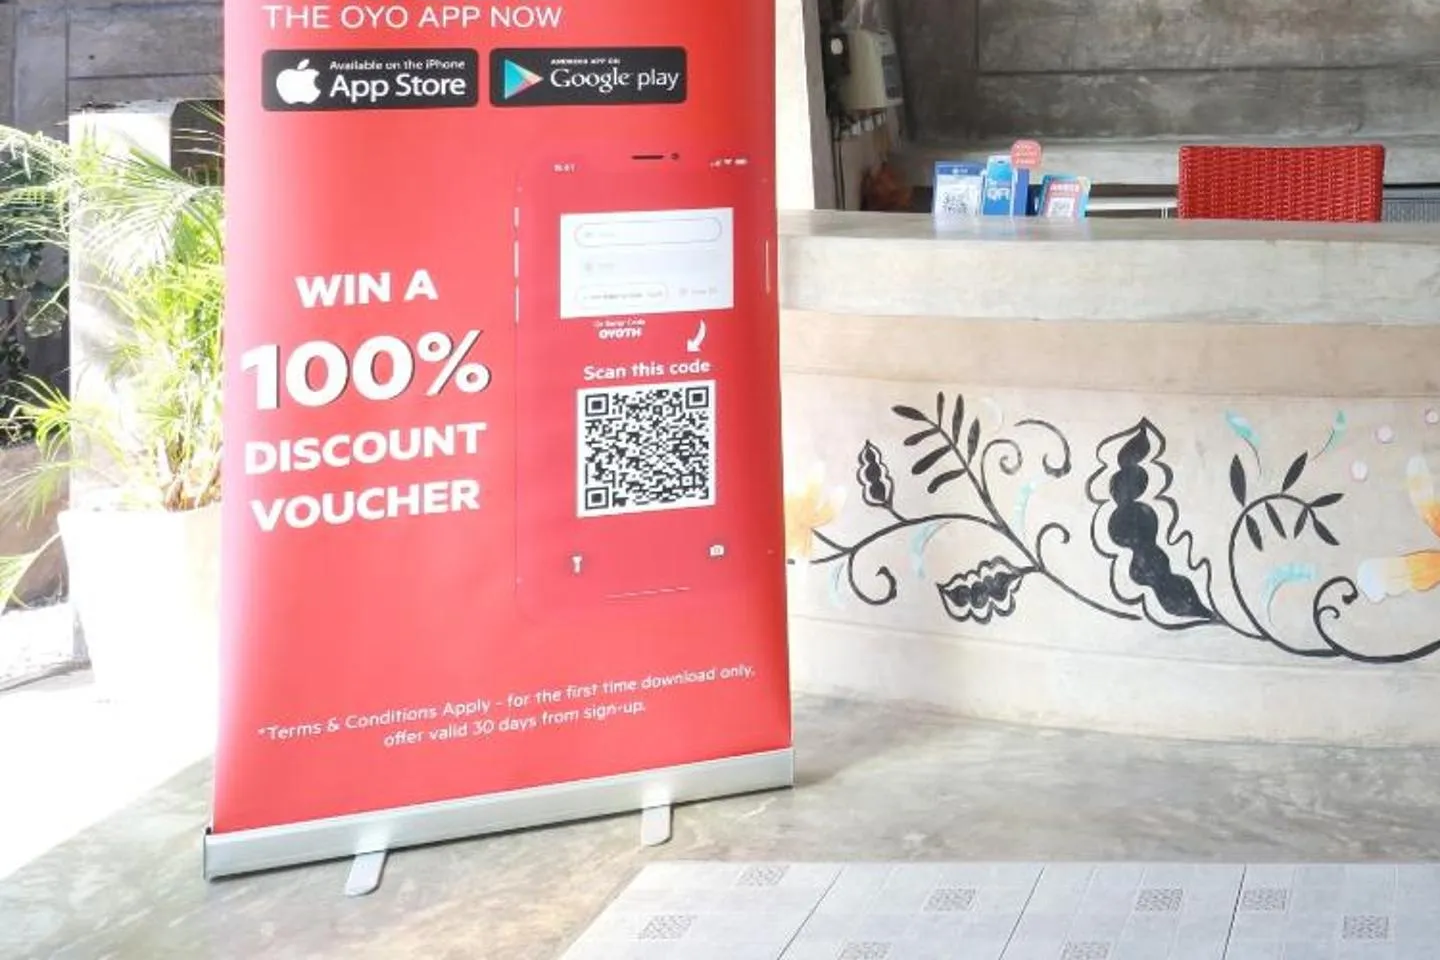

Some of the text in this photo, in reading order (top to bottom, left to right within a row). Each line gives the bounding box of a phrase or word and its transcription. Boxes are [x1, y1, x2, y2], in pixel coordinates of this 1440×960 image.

[262, 5, 563, 29] THE OYO APP NOW
[329, 58, 466, 71] Available on the iPhone
[550, 67, 679, 93] Google play
[329, 72, 466, 103] App Store
[295, 270, 438, 308] WIN A
[240, 329, 492, 411] 100%
[583, 358, 711, 381] Scan this code
[244, 422, 487, 475] DISCOUNT
[250, 480, 480, 532] VOUCHER
[327, 717, 341, 733] &
[345, 706, 437, 730] Conditions
[443, 698, 491, 719] Apply
[507, 693, 530, 708] for
[536, 690, 561, 705] the
[566, 684, 599, 700] first
[603, 680, 637, 695] time
[641, 669, 716, 690] download
[720, 663, 756, 681] only.
[383, 730, 422, 749] offer
[429, 722, 468, 741] valid
[472, 719, 495, 736] 30
[498, 714, 537, 733] days
[542, 709, 579, 726] from
